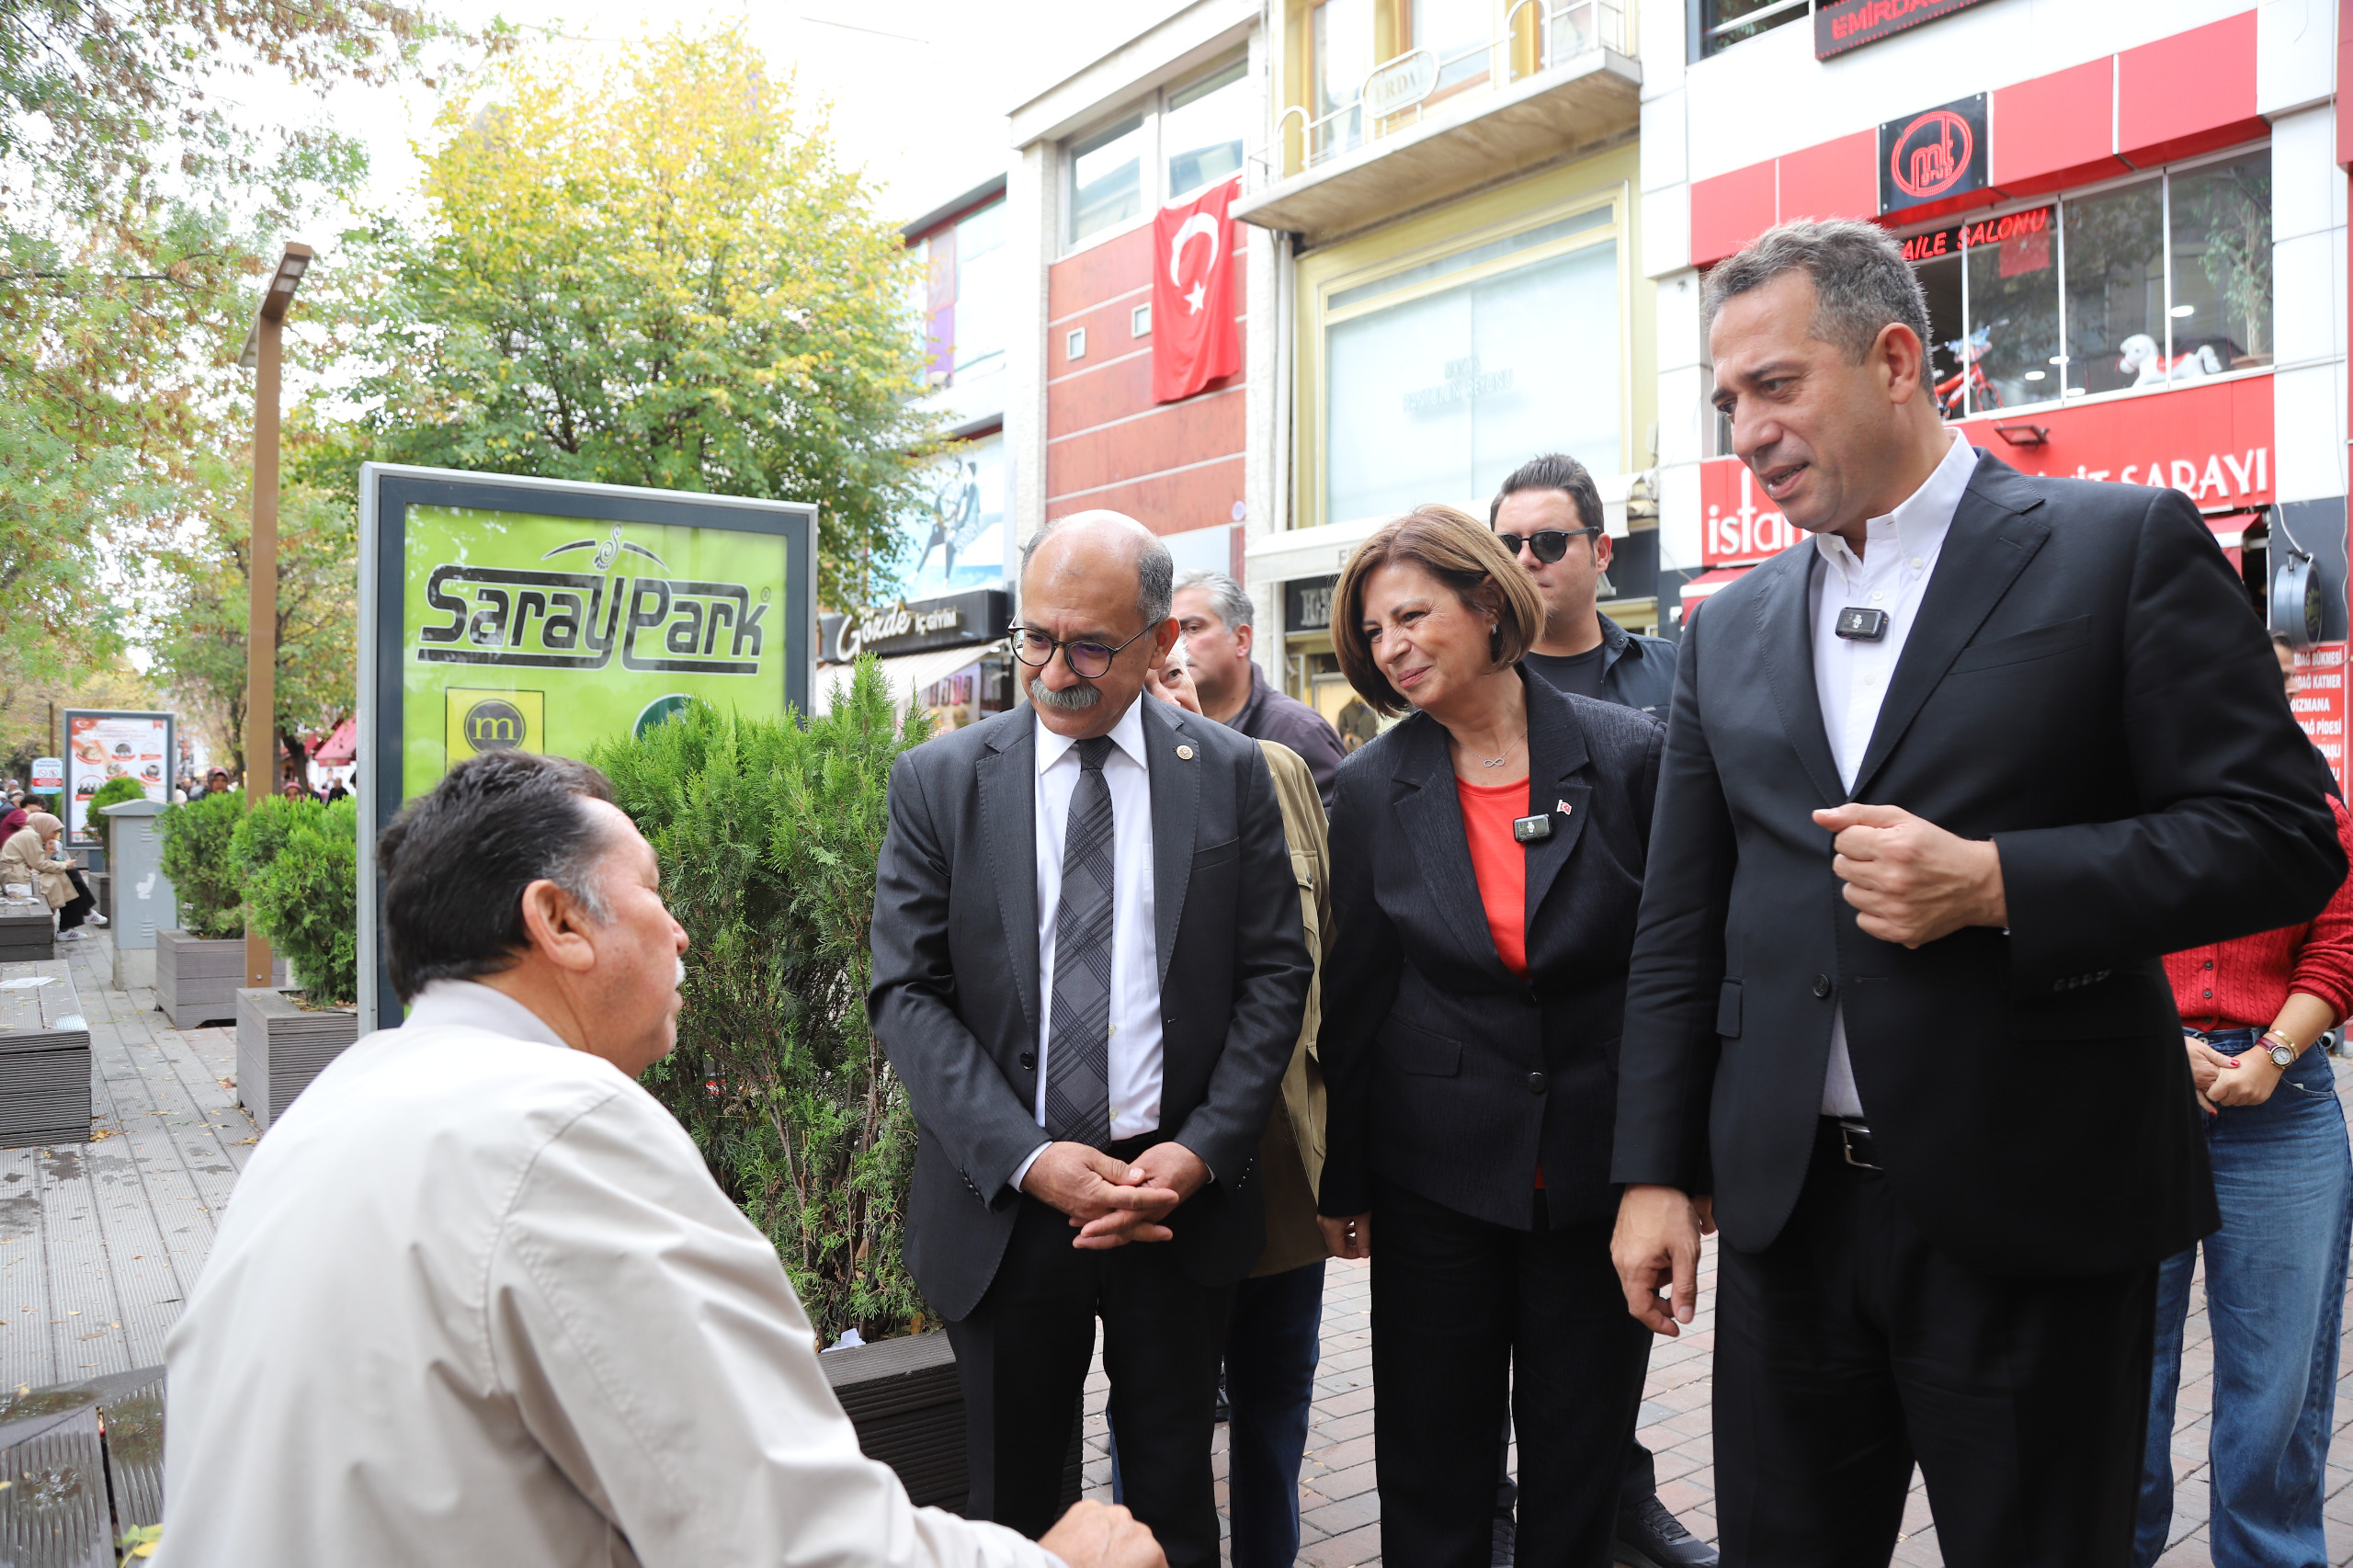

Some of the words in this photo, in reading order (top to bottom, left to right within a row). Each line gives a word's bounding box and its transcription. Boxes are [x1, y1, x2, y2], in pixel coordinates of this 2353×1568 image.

[1832, 0, 1943, 40] EMİRDA
[1957, 209, 2047, 250] SALONU
[835, 600, 912, 662] Gözde
[2312, 647, 2343, 666] BÜKMESİ
[2313, 674, 2342, 689] KATMER
[472, 717, 517, 741] m
[2316, 717, 2342, 735] PİDESİ
